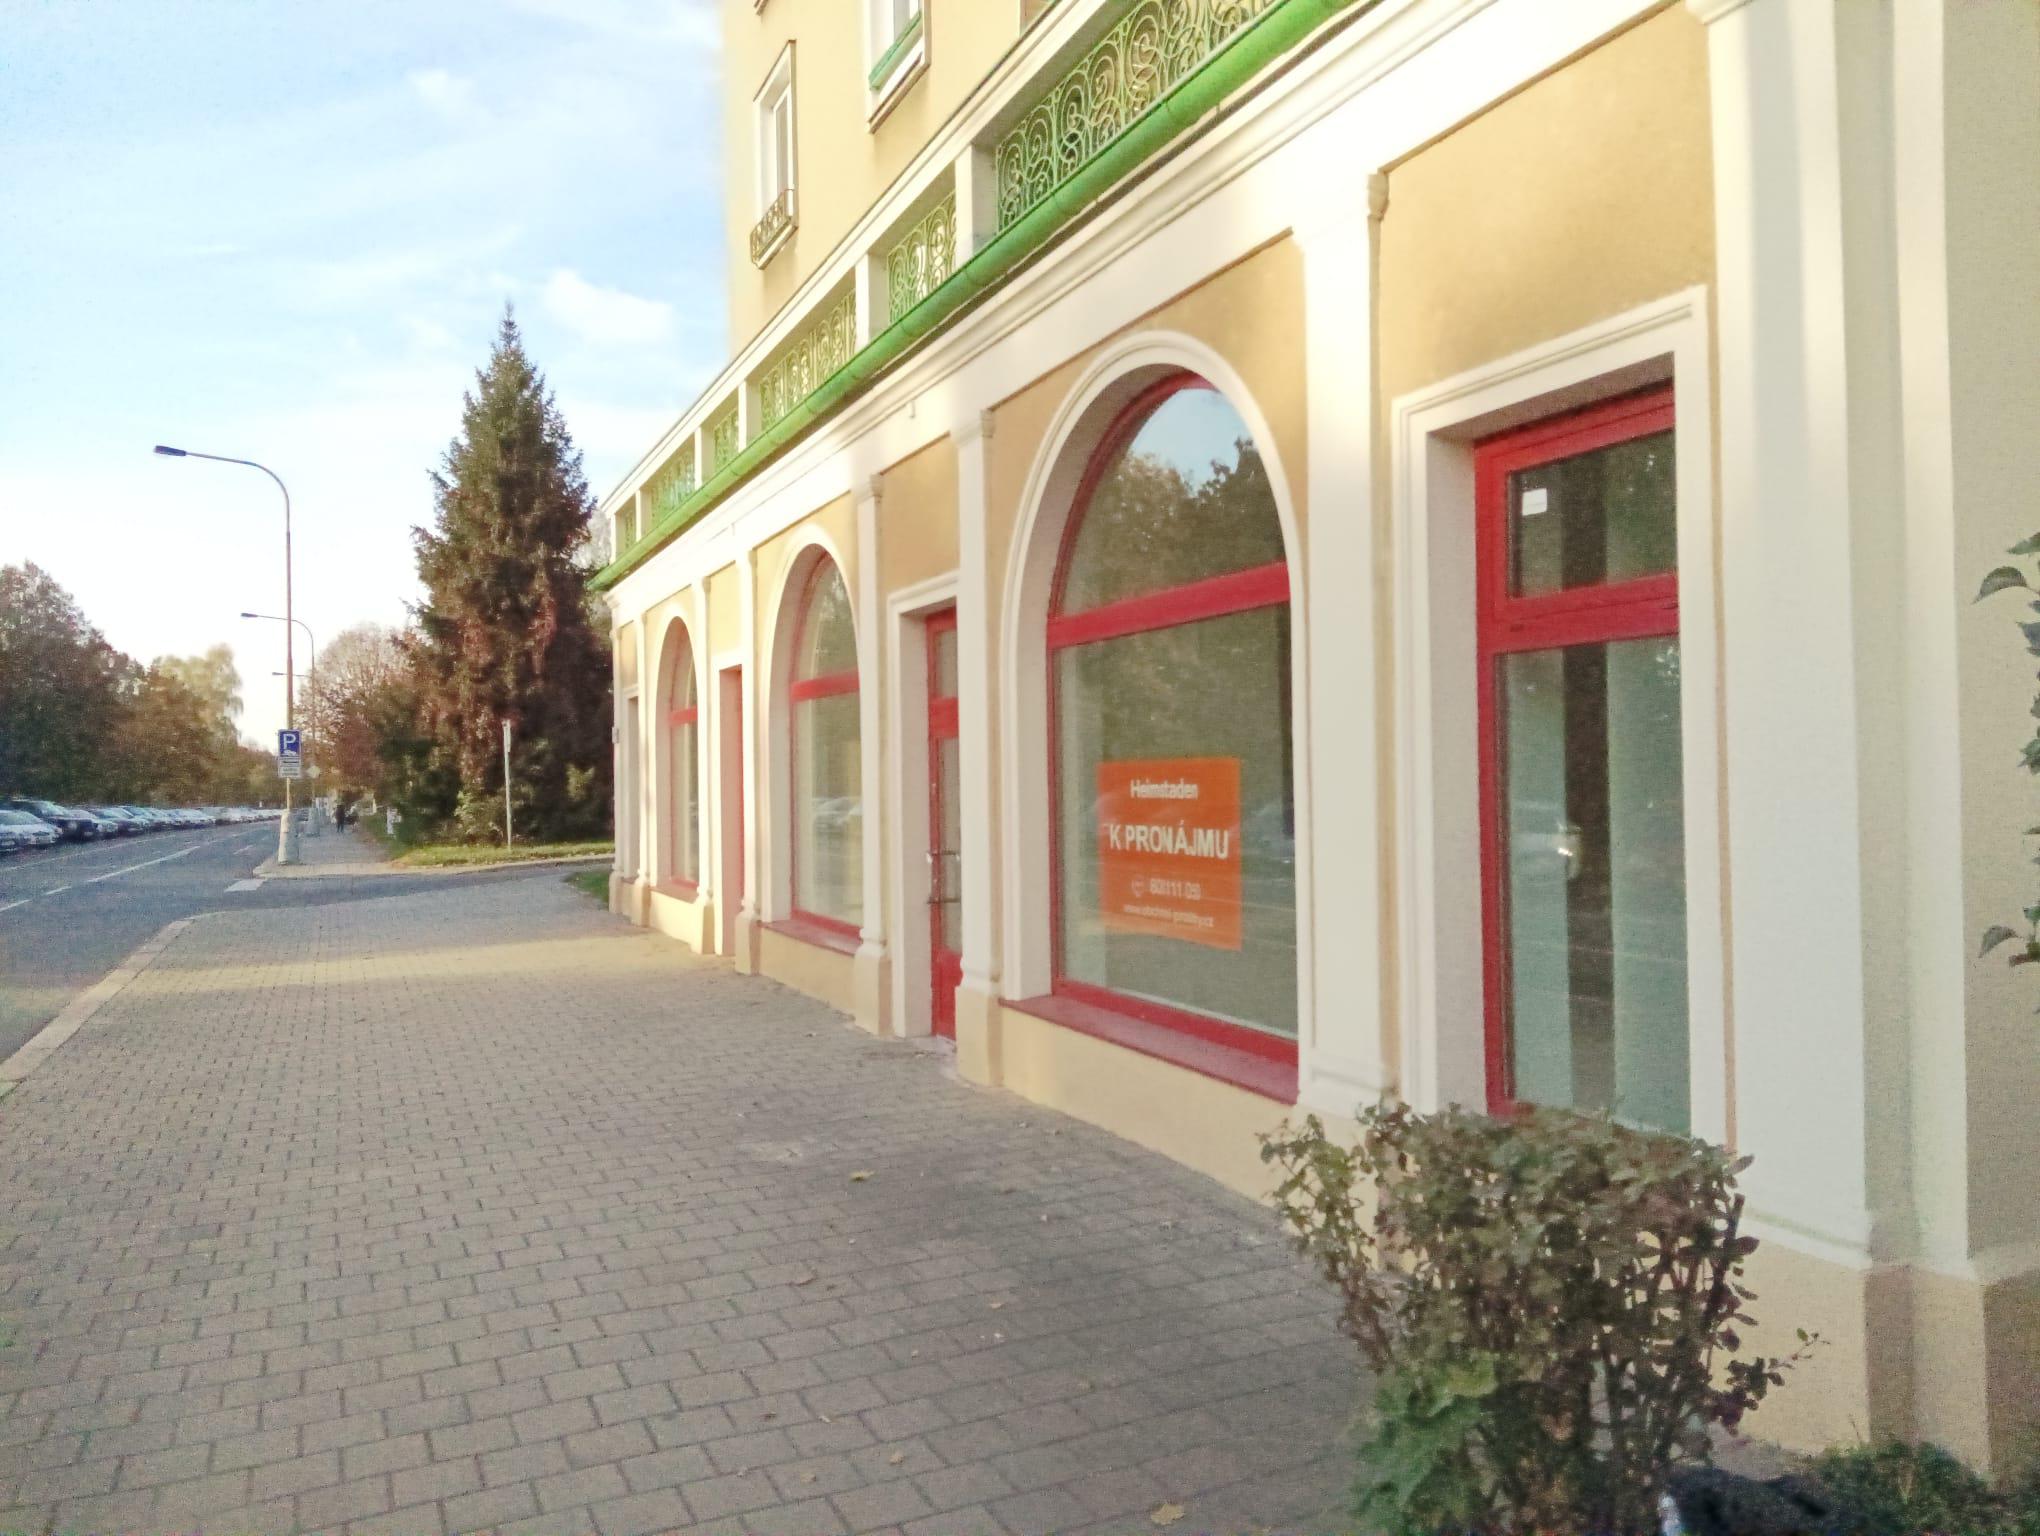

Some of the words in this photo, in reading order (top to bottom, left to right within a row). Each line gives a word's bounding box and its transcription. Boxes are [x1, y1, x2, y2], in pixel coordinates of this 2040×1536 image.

[283, 733, 297, 749] P
[1130, 778, 1199, 800] Heimstaden
[1109, 823, 1122, 851] K
[1125, 819, 1229, 860] PRONÁJMU
